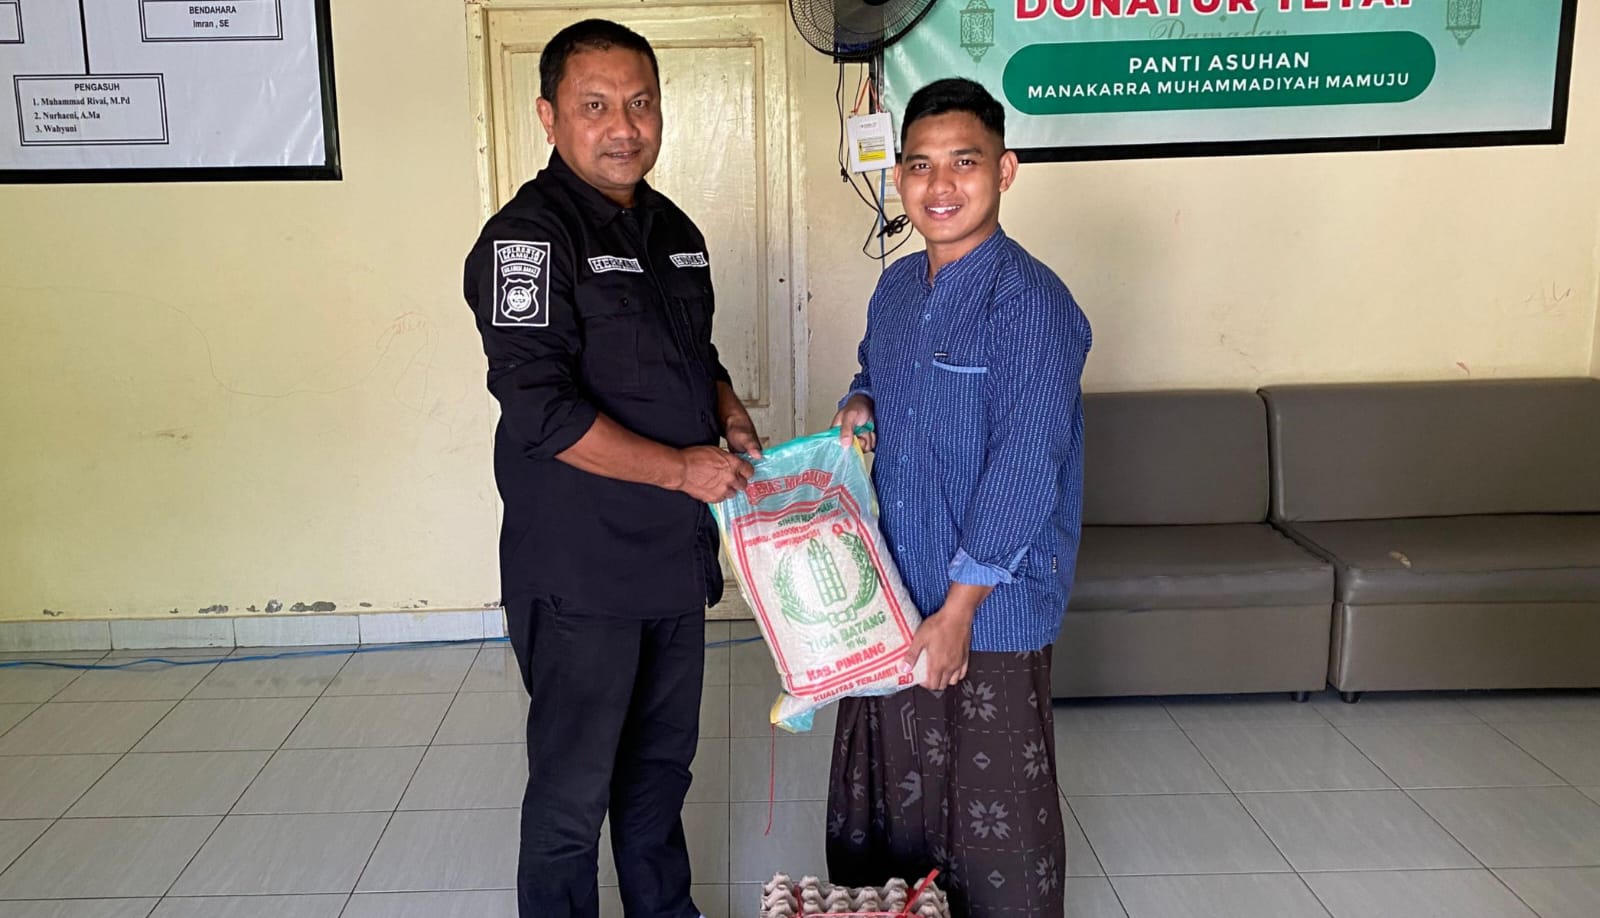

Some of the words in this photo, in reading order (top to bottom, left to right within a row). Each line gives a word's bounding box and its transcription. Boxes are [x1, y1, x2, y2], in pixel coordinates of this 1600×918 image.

[189, 6, 237, 14] BENDAHARA
[193, 19, 214, 28] Imran
[219, 19, 230, 27] SE
[1129, 56, 1200, 73] PANTI
[1208, 52, 1310, 71] ASUHAN
[74, 83, 120, 92] PENGASUH
[1028, 81, 1151, 98] MANAKARRA
[1158, 76, 1319, 95] MUHAMMADIYAH
[1326, 73, 1409, 88] MAMUJU
[33, 98, 40, 106] 1.
[110, 96, 131, 105] M.Pd
[34, 112, 41, 120] 2.
[44, 124, 77, 134] Wahyuni
[804, 632, 838, 654] TIGA
[840, 611, 886, 641] BATANG
[836, 642, 886, 671] PINRANG
[813, 682, 855, 702] KUALITAS
